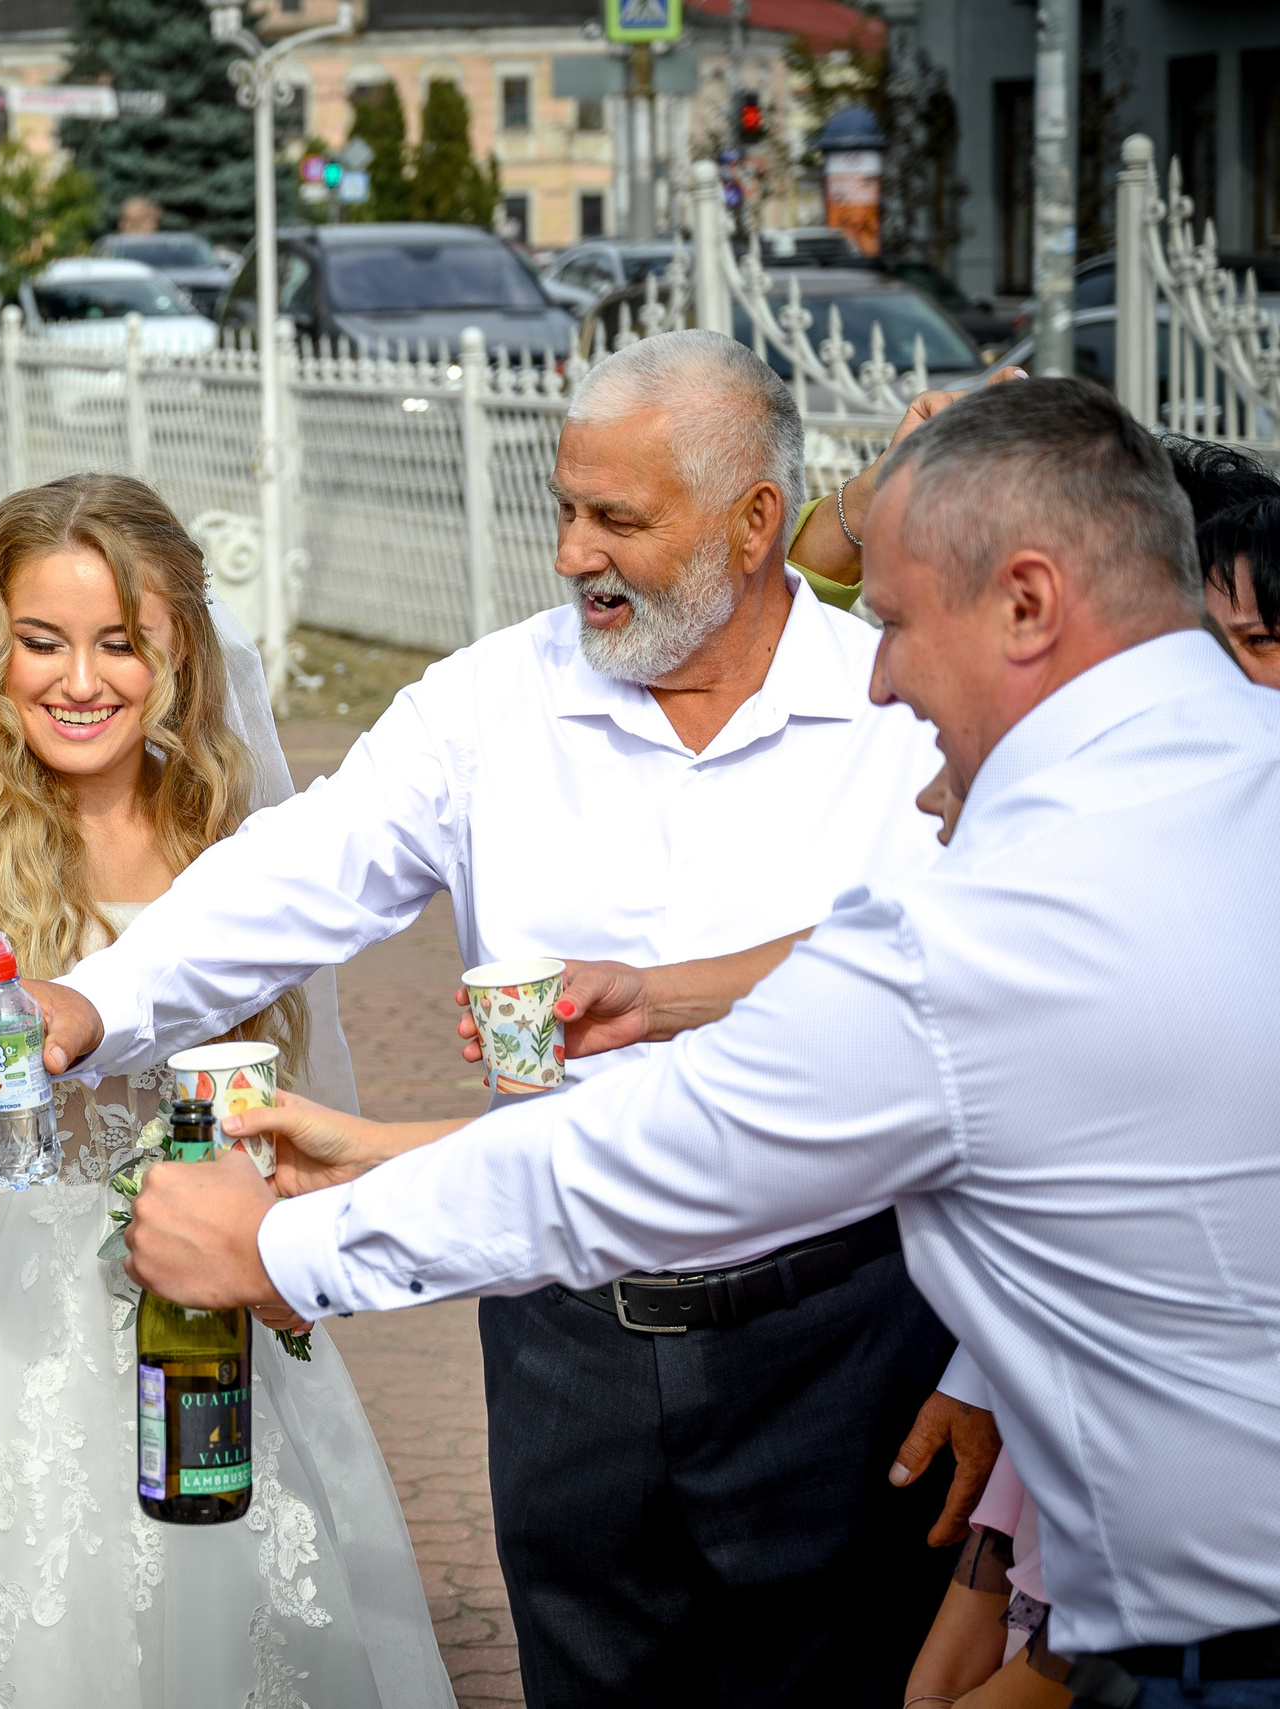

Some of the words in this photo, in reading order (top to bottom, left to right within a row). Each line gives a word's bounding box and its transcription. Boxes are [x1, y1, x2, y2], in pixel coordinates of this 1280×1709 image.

[6, 1046, 16, 1055] 0+
[199, 1447, 247, 1465] VALLI
[184, 1469, 251, 1487] LAMBRUSC
